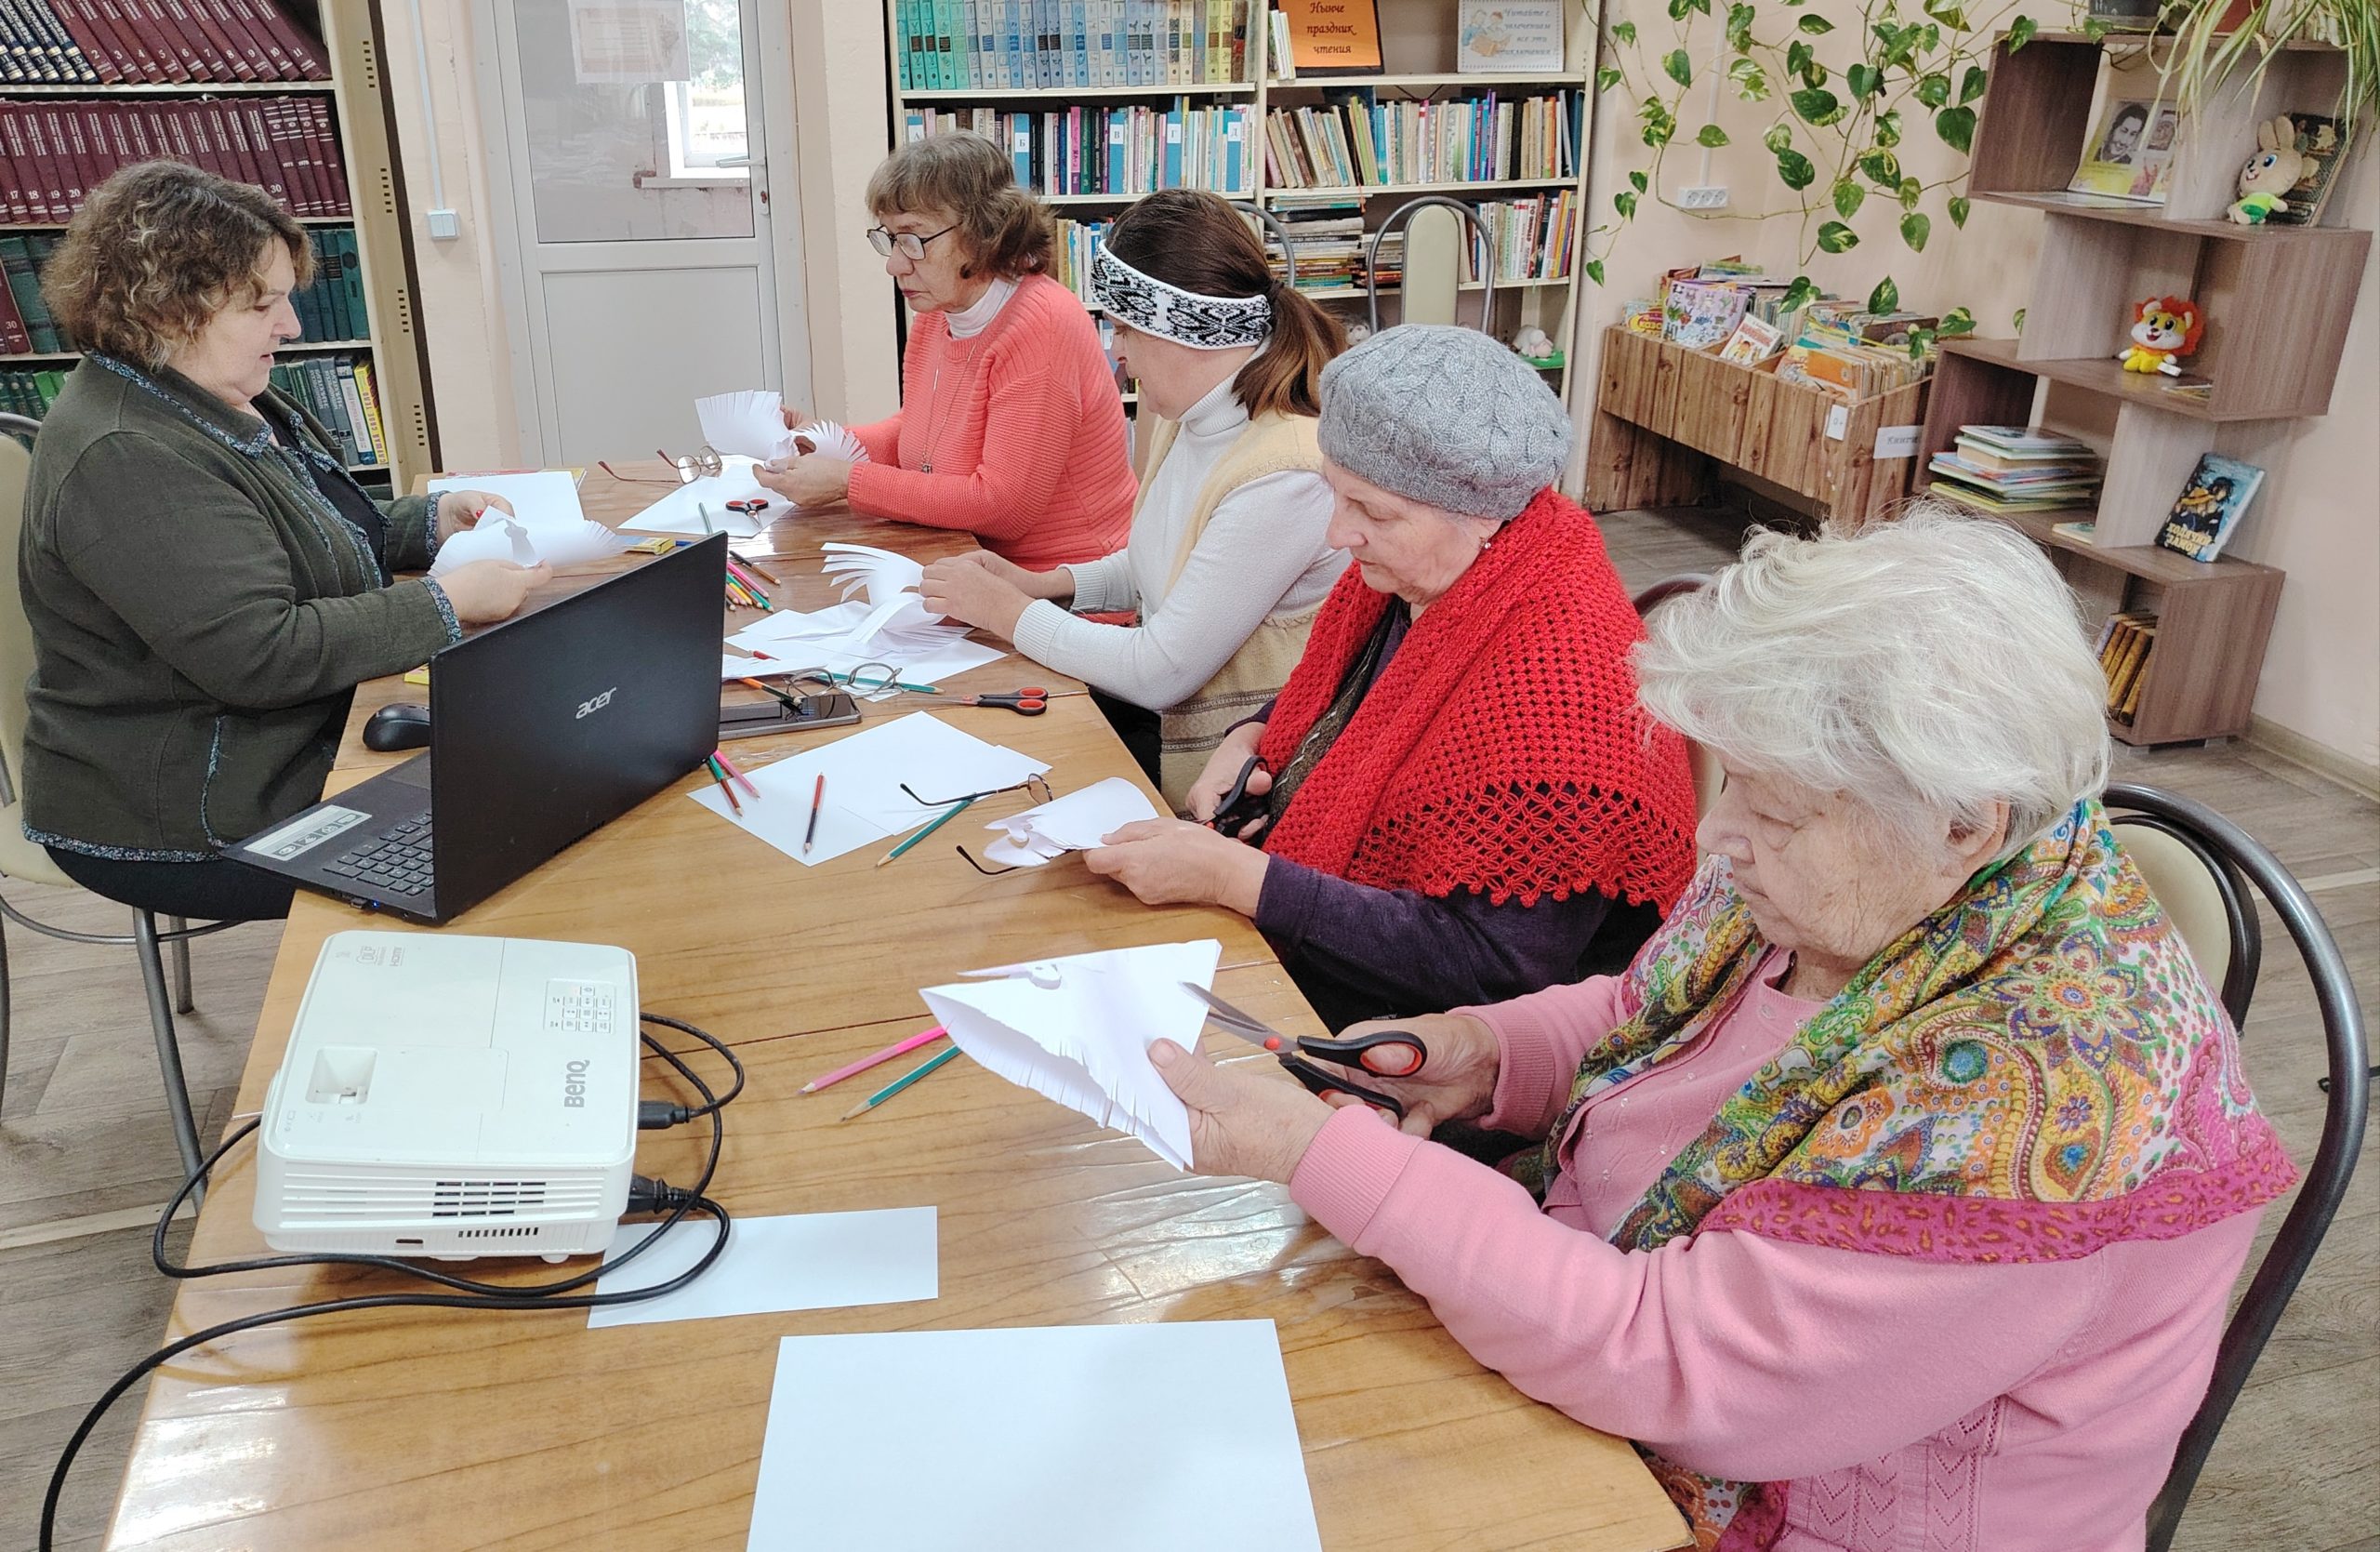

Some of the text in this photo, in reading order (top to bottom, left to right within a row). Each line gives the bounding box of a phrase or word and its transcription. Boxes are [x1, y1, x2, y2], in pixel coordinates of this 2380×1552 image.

[1309, 1, 1345, 14] Нынче
[1306, 20, 1357, 37] праздник
[91, 50, 100, 59] 2
[138, 49, 146, 59] 4
[158, 50, 165, 59] 5
[181, 48, 190, 58] 6
[204, 49, 211, 58] 7
[226, 49, 234, 59] 8
[247, 49, 256, 58] 9
[271, 47, 280, 58] 10
[293, 48, 303, 58] 11
[1314, 45, 1352, 55] чтения
[19, 55, 29, 63] 12
[36, 55, 46, 63] 13
[113, 50, 123, 60] 3
[73, 56, 83, 64] 15
[1114, 131, 1120, 139] В
[1171, 130, 1177, 139] Г
[1231, 127, 1237, 139] Д
[1019, 139, 1026, 147] Б
[270, 184, 282, 193] 30
[9, 191, 19, 199] 17
[28, 190, 39, 200] 18
[50, 190, 60, 199] 19
[69, 189, 81, 198] 20
[6, 321, 18, 330] 30
[575, 686, 616, 719] acer
[563, 1059, 590, 1108] BenQ
